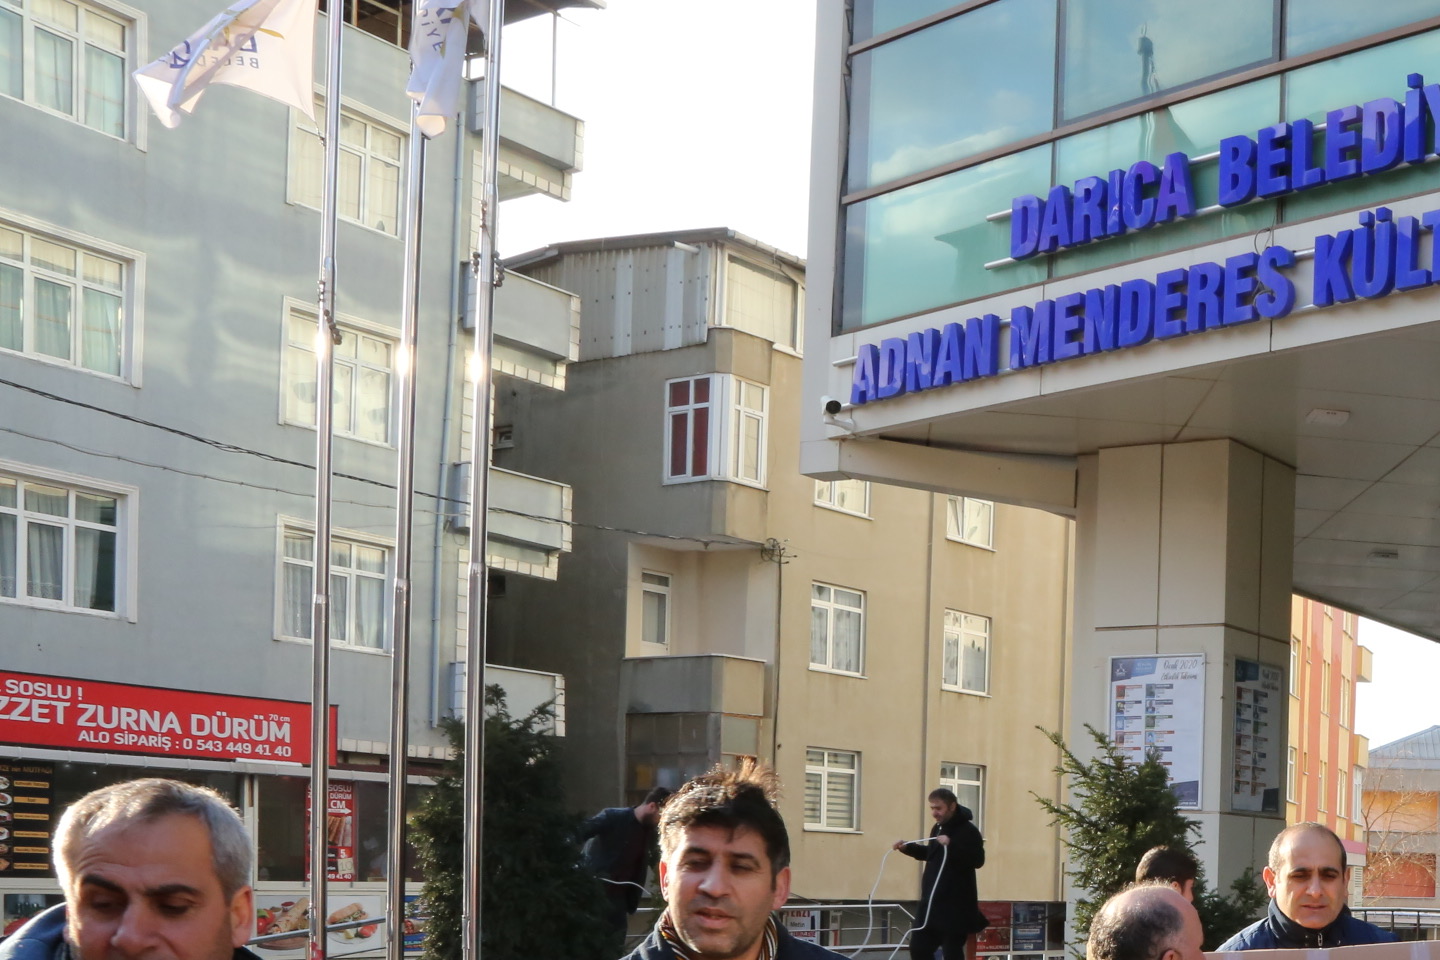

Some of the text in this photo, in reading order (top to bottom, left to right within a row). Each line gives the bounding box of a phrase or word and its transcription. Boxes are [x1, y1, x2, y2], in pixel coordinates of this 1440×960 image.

[1010, 151, 1196, 260] DARICA
[850, 314, 999, 405] ADNAN
[1010, 244, 1296, 371] MENDERES
[5, 679, 72, 700] SOSLU
[77, 703, 182, 734] ZURNA
[190, 711, 291, 743] DÜRÜM
[78, 730, 110, 743] ALO
[114, 731, 172, 751] SİPARİŞ
[182, 738, 193, 750] 0
[196, 739, 223, 752] 543
[226, 742, 252, 754] 449
[255, 744, 271, 756] 41
[274, 746, 292, 757] 40
[330, 800, 346, 809] CM
